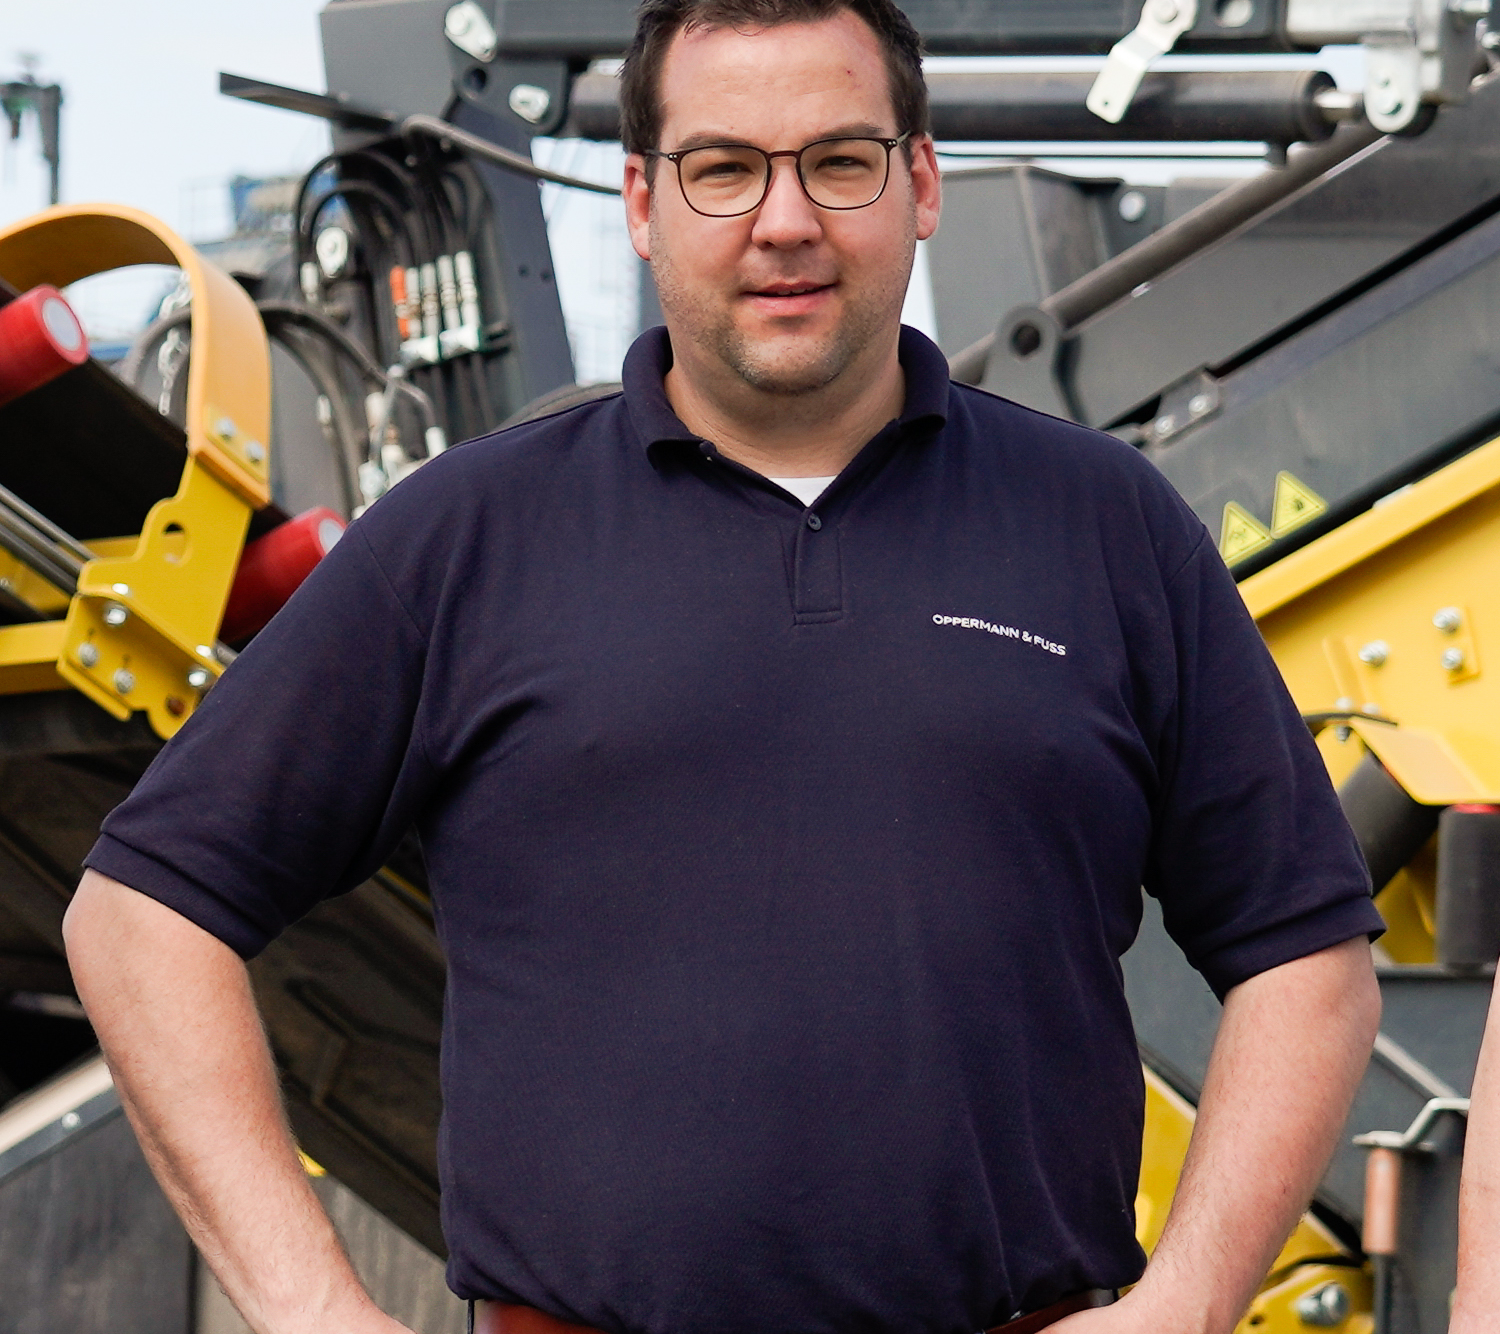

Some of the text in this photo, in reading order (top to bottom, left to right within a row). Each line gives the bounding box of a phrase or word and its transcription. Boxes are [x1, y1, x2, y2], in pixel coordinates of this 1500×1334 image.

[932, 613, 1067, 656] OPPERMANN & FUSS
